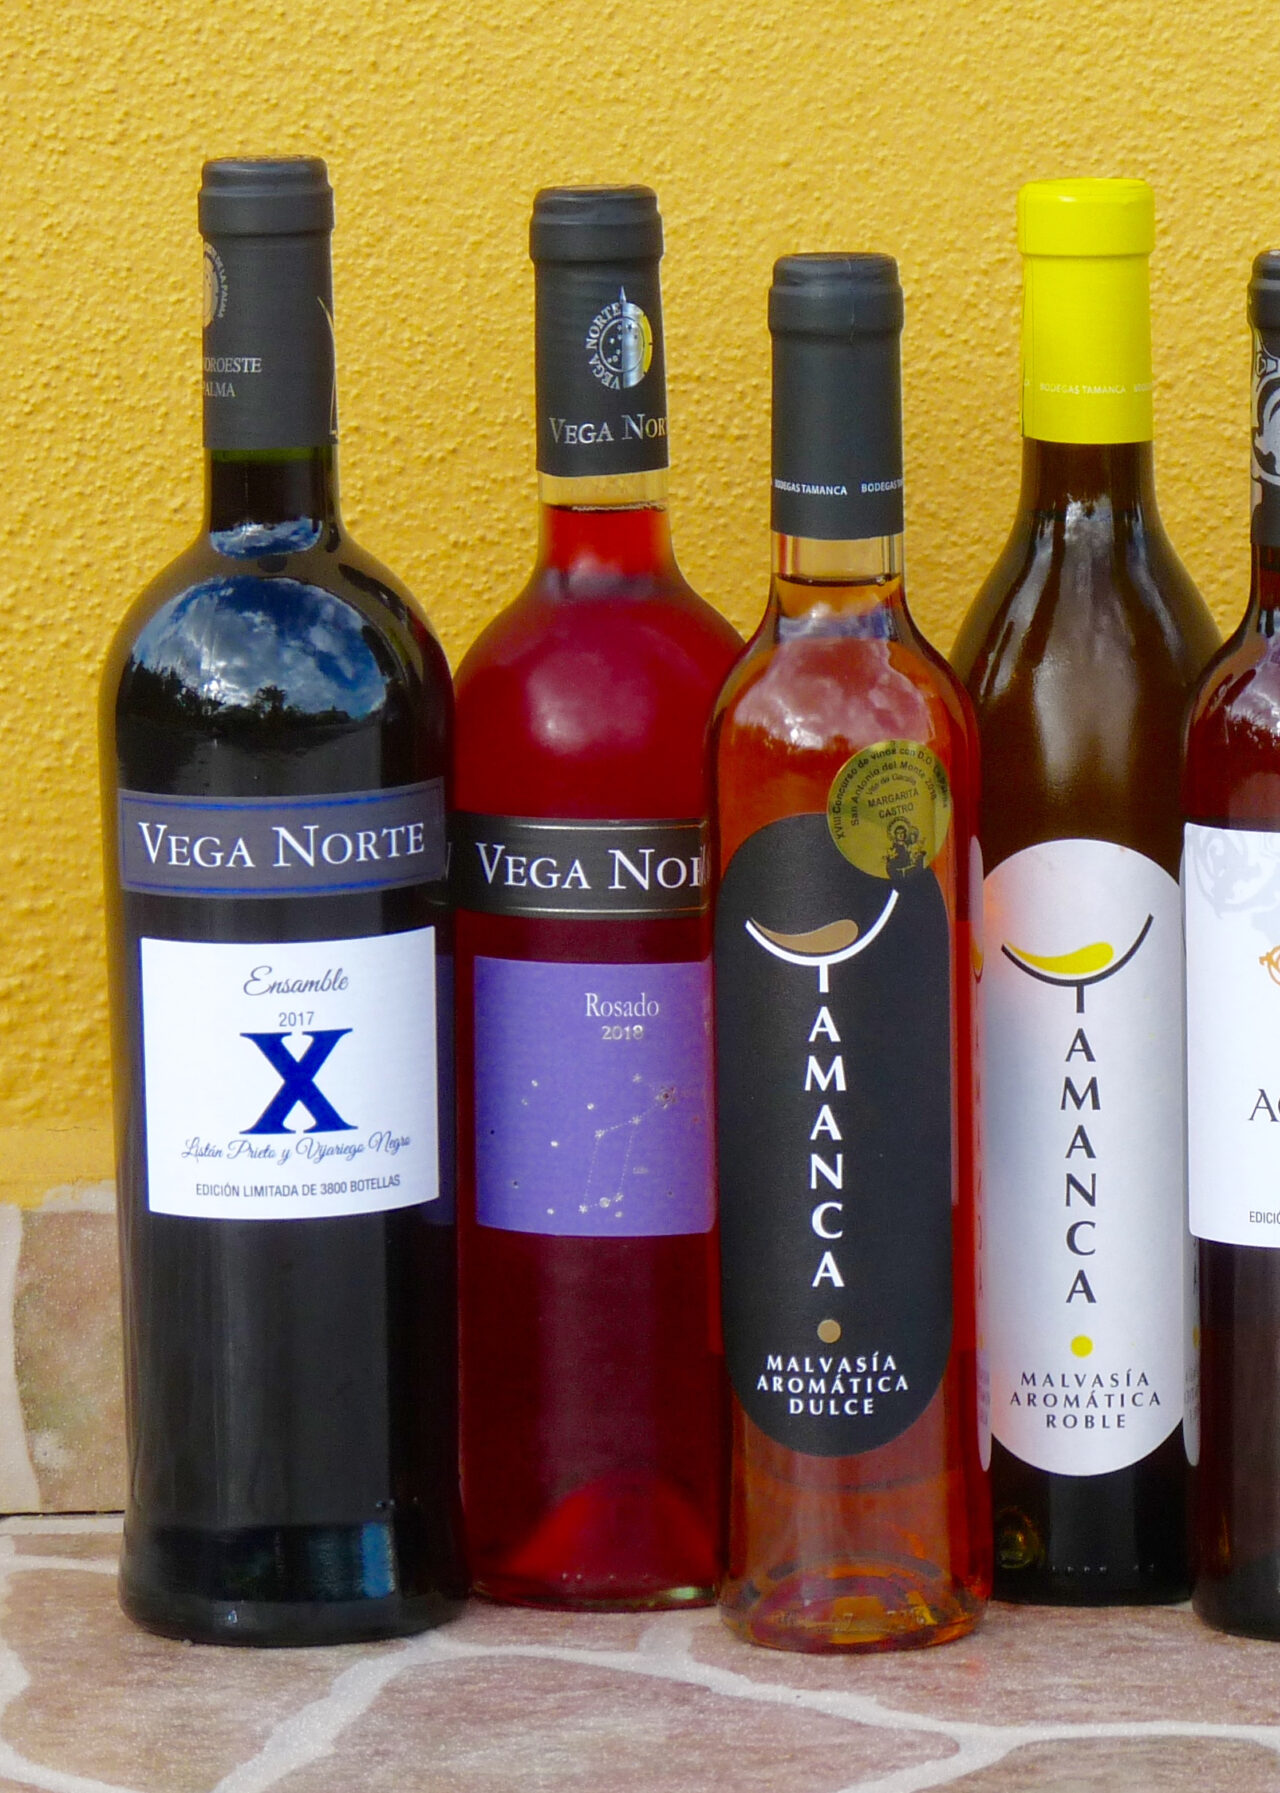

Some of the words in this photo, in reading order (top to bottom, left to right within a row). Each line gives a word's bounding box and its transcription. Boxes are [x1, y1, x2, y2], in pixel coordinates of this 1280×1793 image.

[586, 302, 622, 350] NORTE
[589, 353, 620, 390] VEGA
[204, 382, 236, 397] ALMA
[549, 418, 614, 444] VEGA
[621, 413, 667, 440] NOR
[801, 484, 848, 496] TAMANCA
[861, 480, 897, 493] BODEGAS
[882, 762, 897, 771] del
[832, 768, 858, 813] Concurso
[858, 758, 870, 768] de
[854, 768, 880, 804] Antonio
[868, 788, 919, 807] MARGARITA
[851, 805, 860, 826] San
[879, 802, 914, 819] CASTRO
[138, 821, 255, 869] VEGA
[272, 821, 424, 869] NORTE
[476, 842, 591, 890] VEGA
[243, 965, 349, 996] Ensamble
[585, 993, 659, 1018] Rosado
[278, 1011, 315, 1028] 2017
[602, 1025, 644, 1040] 2018
[239, 1028, 358, 1134] X
[181, 1137, 222, 1162] Listán
[226, 1140, 275, 1159] Prieto
[277, 1147, 292, 1165] y
[368, 1131, 411, 1155] Negro
[196, 1182, 239, 1197] EDICIÓN
[244, 1183, 298, 1197] LIMITADA
[302, 1184, 316, 1196] DE
[320, 1181, 347, 1195] 3800
[350, 1174, 400, 1193] BOTELLAS
[767, 1350, 897, 1373] MALVASÍA
[757, 1373, 909, 1395] AROMÁTICA
[1021, 1368, 1149, 1388] MALVASÍA
[788, 1398, 875, 1417] DULCE
[1010, 1390, 1161, 1409] AROMÁTICA
[1046, 1413, 1126, 1430] ROBLE
